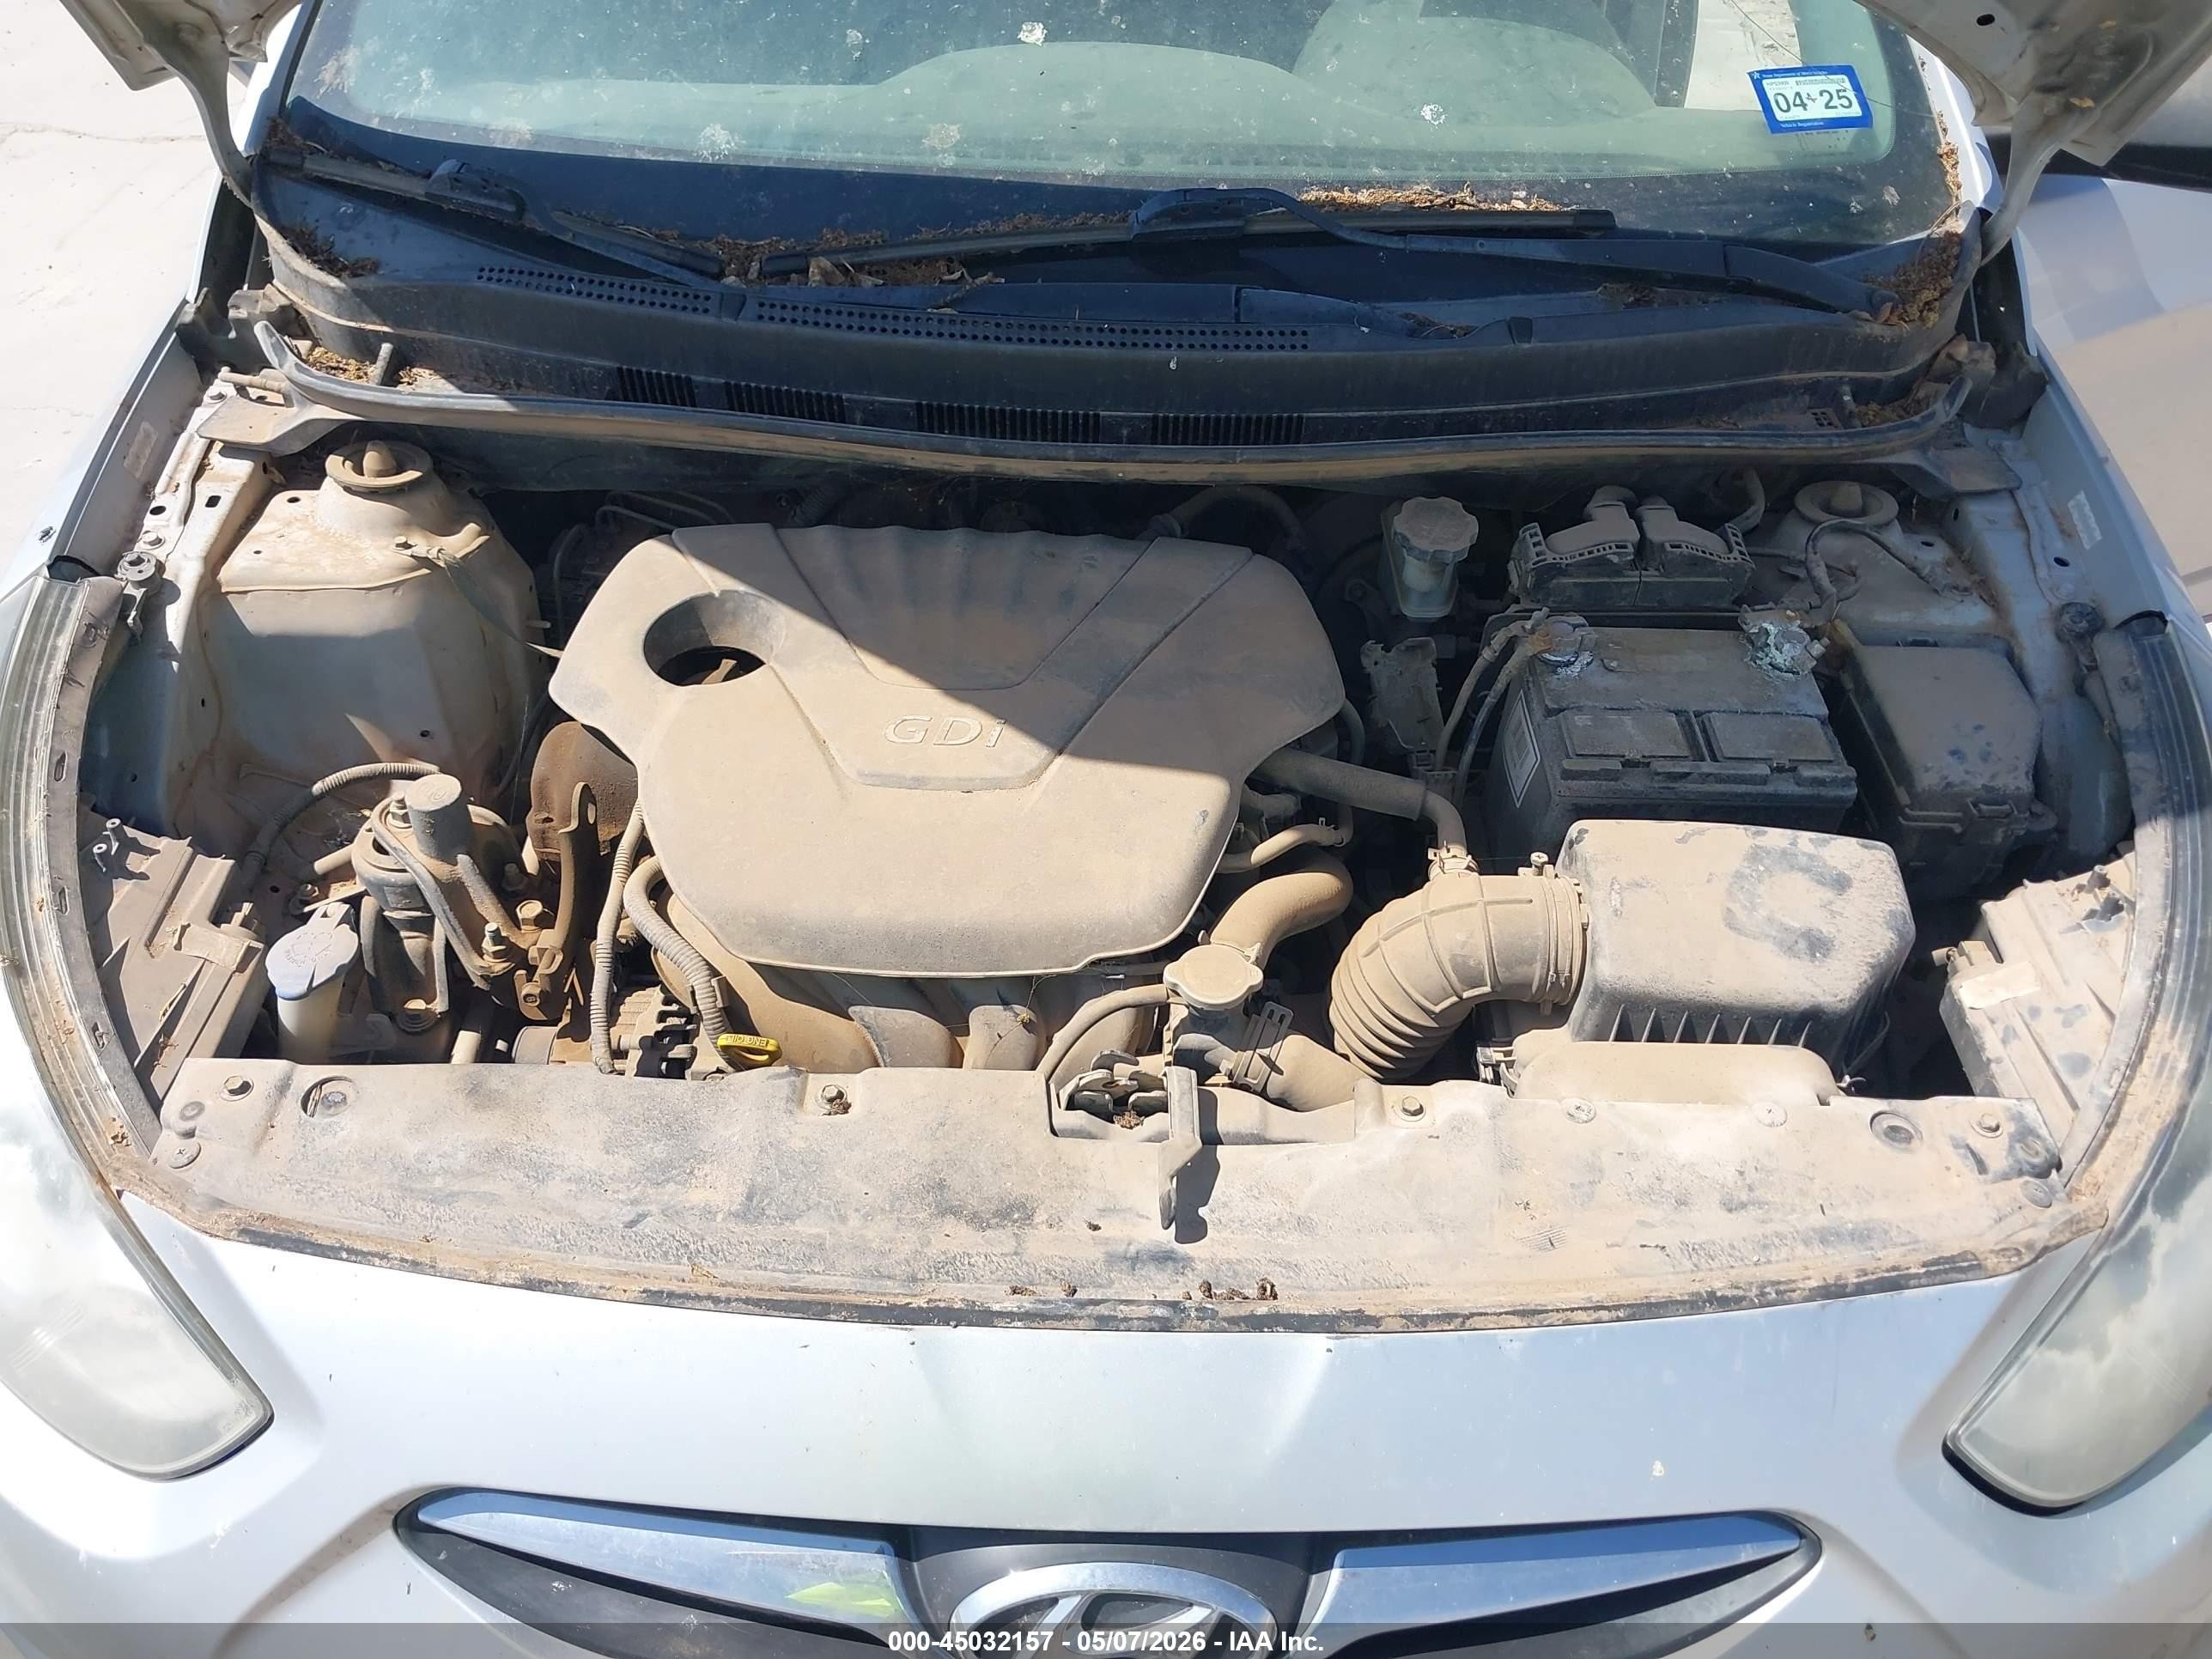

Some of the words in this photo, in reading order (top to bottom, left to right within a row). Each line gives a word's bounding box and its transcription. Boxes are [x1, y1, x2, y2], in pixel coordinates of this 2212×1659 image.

[1773, 91, 1808, 113] 04
[1819, 88, 1853, 110] 25
[883, 714, 1006, 748] GDi
